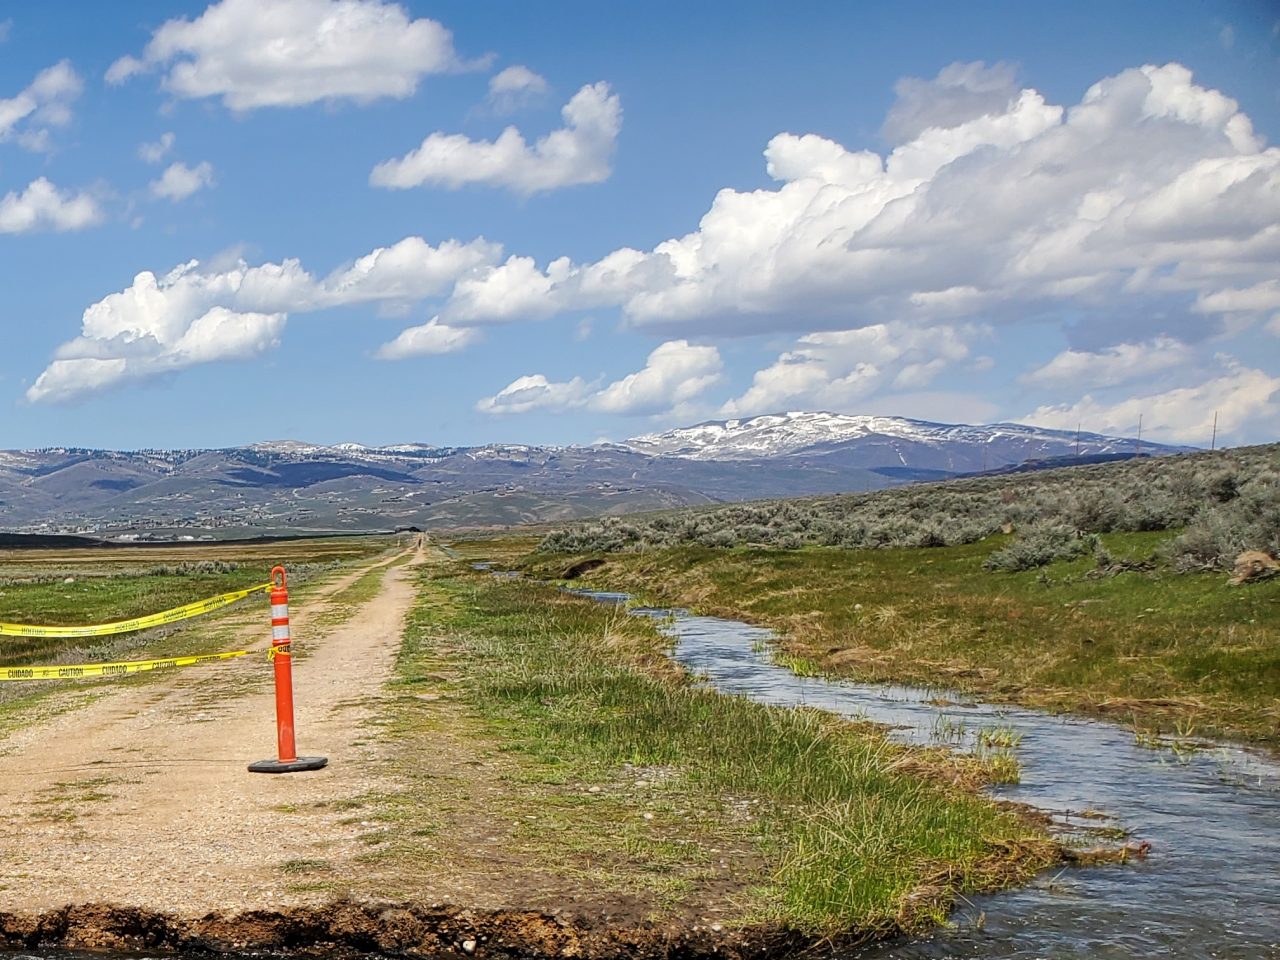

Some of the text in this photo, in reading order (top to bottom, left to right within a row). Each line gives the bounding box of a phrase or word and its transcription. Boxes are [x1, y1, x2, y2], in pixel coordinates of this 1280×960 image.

[7, 669, 34, 679] CUIDADO
[58, 667, 84, 677] CAUTION
[101, 664, 128, 675] CUIDADO
